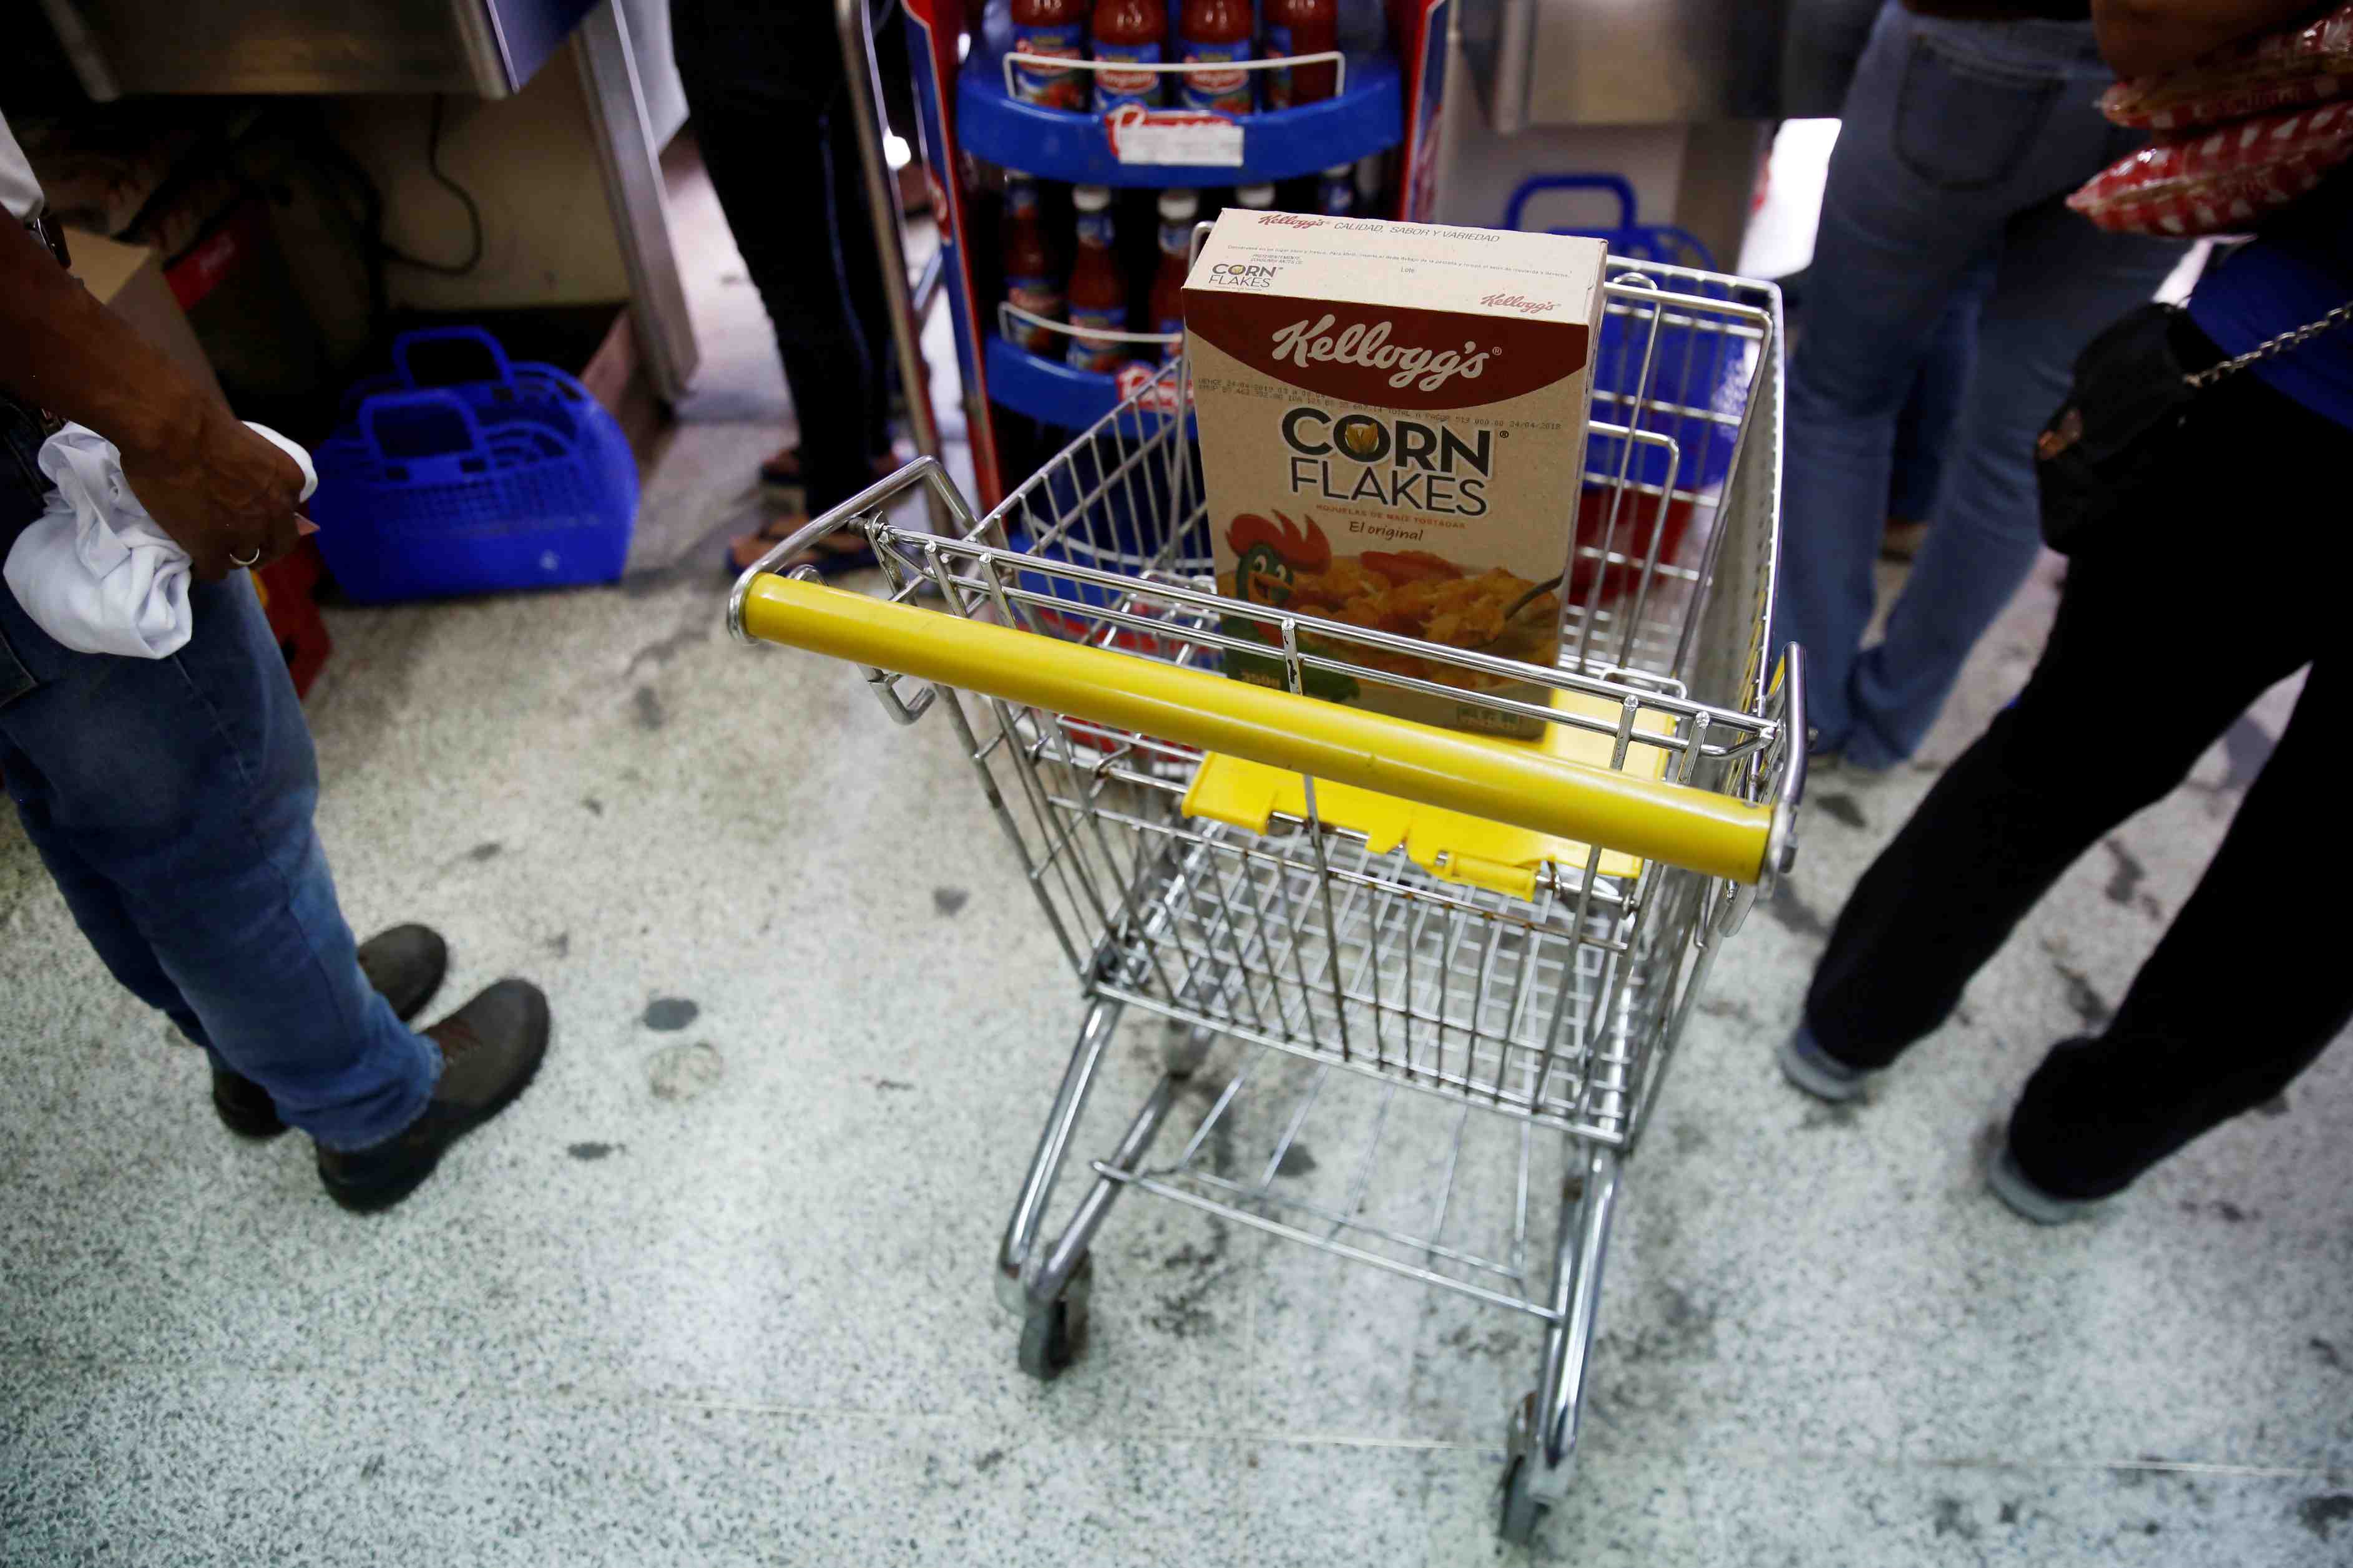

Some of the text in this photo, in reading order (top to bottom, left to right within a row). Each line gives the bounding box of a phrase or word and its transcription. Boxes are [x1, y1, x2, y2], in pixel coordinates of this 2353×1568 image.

[1258, 213, 1324, 229] Kellogg's
[1389, 226, 1429, 236] SABOR
[1442, 231, 1500, 243] VARIEDAD
[1208, 275, 1271, 288] FLAKES
[1211, 263, 1277, 278] CORN
[1480, 293, 1555, 314] Kellogg's
[1271, 313, 1490, 392] Kellogg's
[1281, 407, 1490, 477] CORN
[1291, 456, 1487, 517] FLAKES
[1316, 504, 1367, 517] HOJUELAS
[1370, 510, 1384, 519] DE
[1414, 517, 1467, 530] TOSTADAS
[1349, 520, 1424, 542] El original
